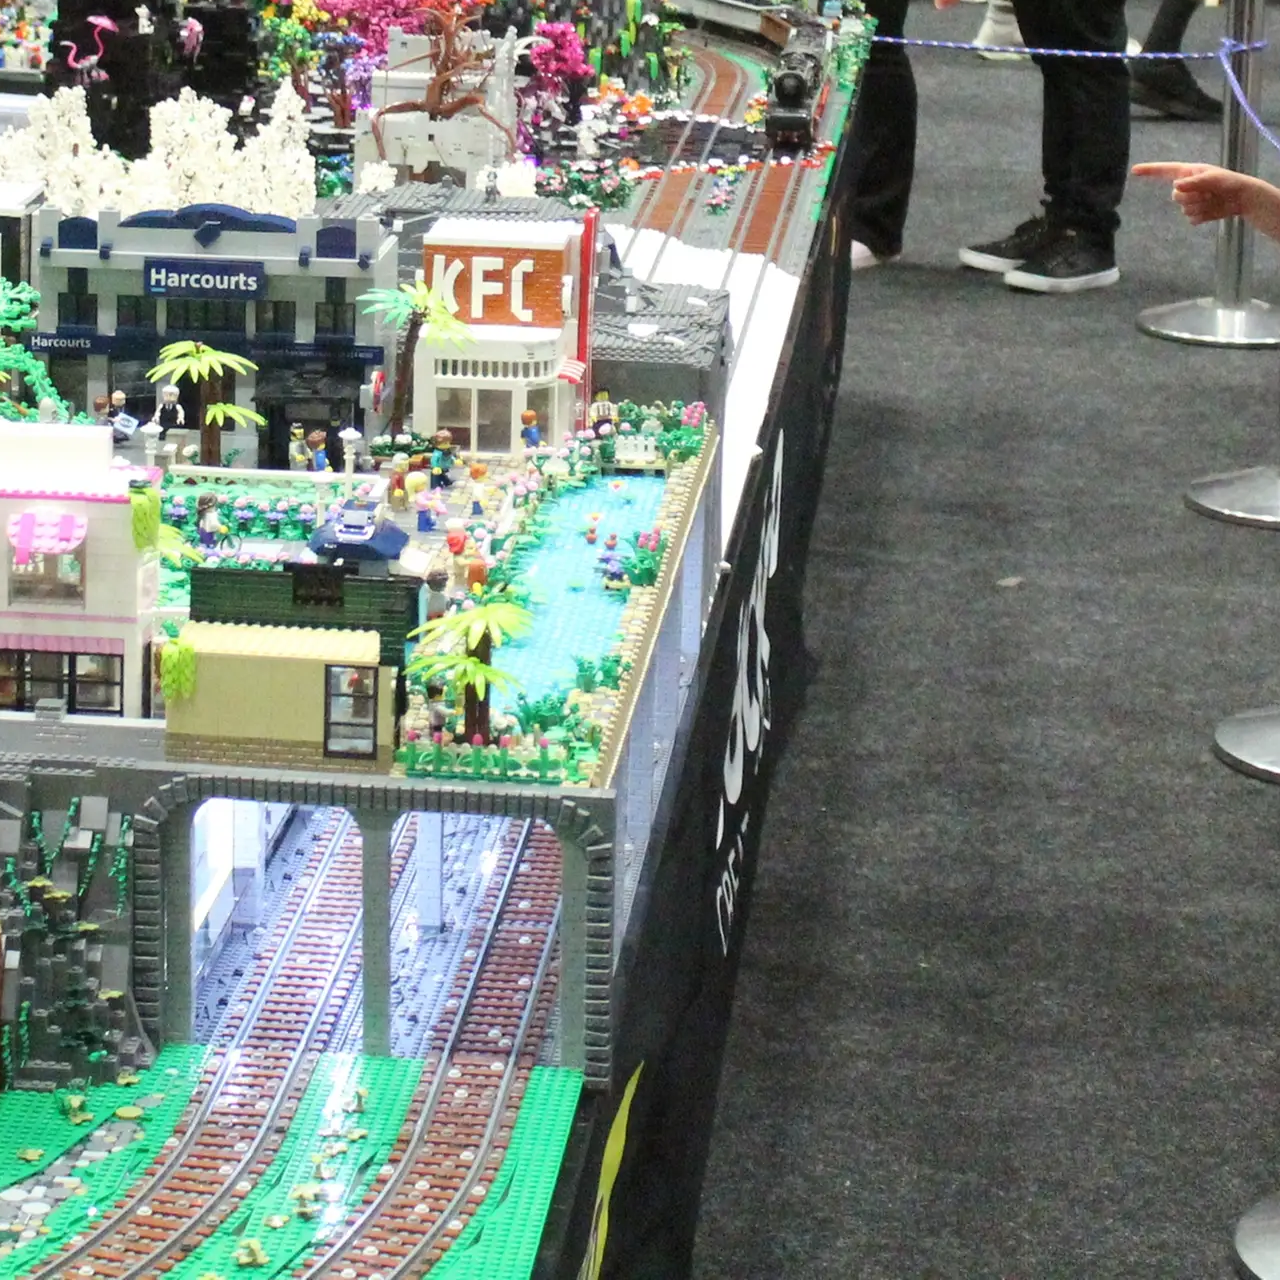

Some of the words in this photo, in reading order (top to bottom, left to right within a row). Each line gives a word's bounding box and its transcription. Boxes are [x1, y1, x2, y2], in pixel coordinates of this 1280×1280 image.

[150, 267, 258, 292] Harcourts
[432, 254, 535, 322] KFC
[30, 335, 92, 349] Harcourts
